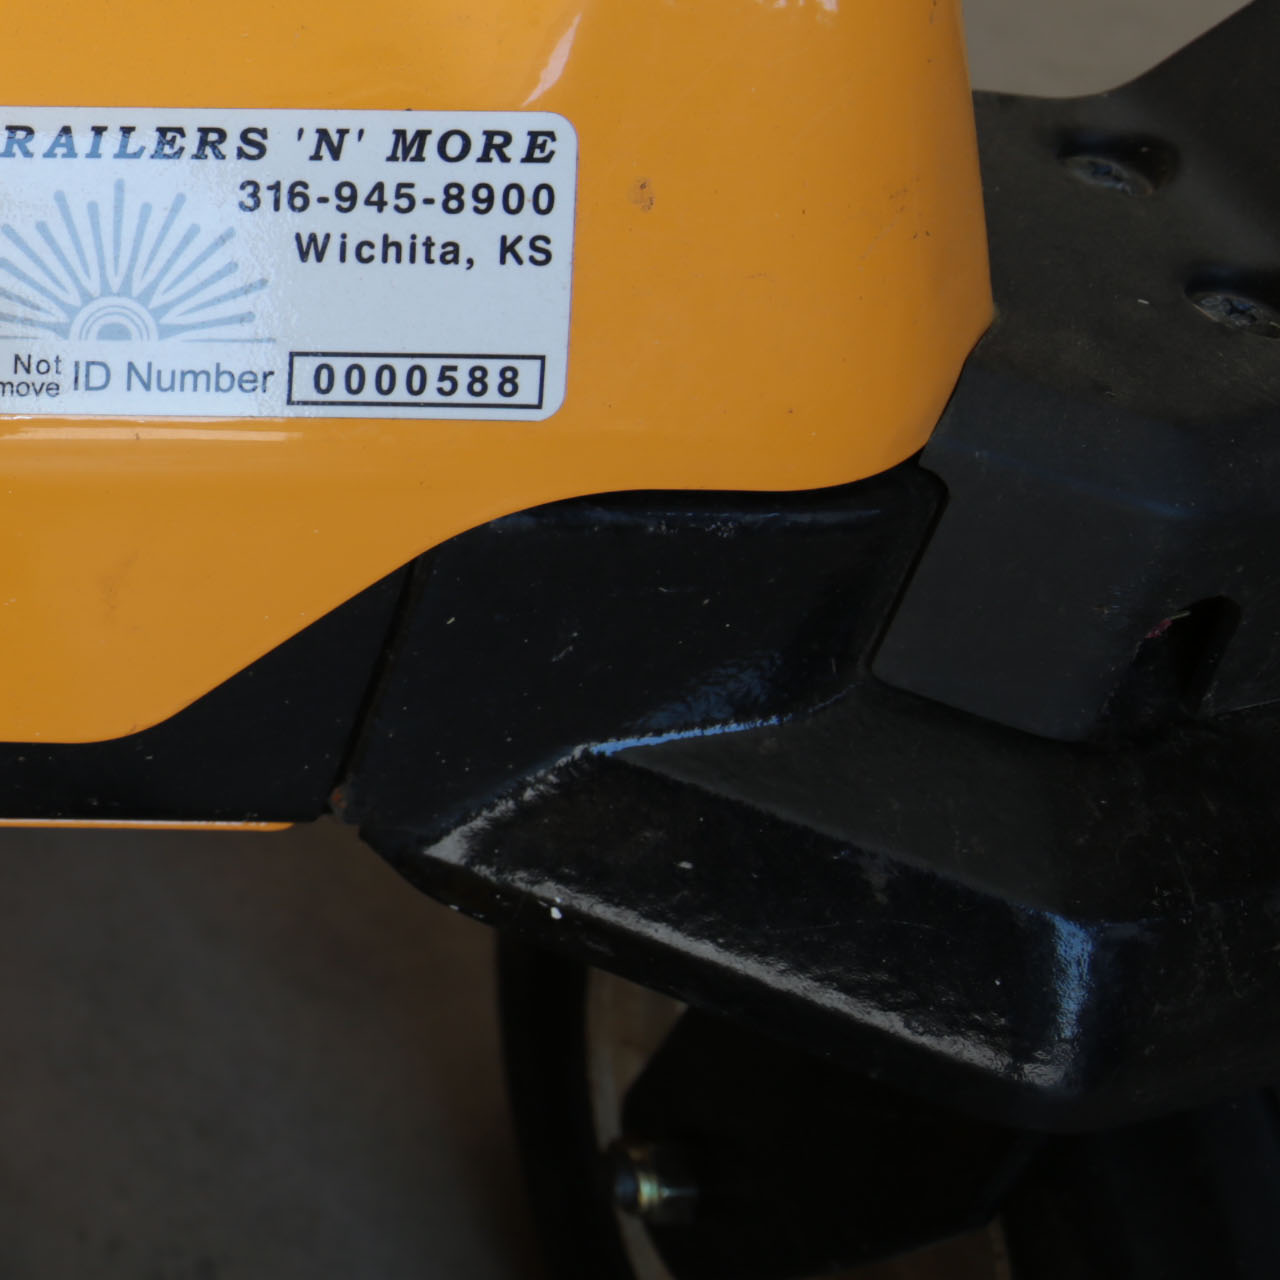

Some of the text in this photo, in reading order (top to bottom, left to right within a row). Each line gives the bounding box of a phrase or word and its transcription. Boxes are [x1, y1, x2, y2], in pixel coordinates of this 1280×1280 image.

[295, 127, 366, 162] 'N'
[385, 128, 559, 164] MORE
[237, 180, 557, 216] 316-945-8900
[293, 232, 554, 271] Wichita, KS
[13, 353, 63, 376] Not
[72, 361, 521, 398] ID Number 0000588
